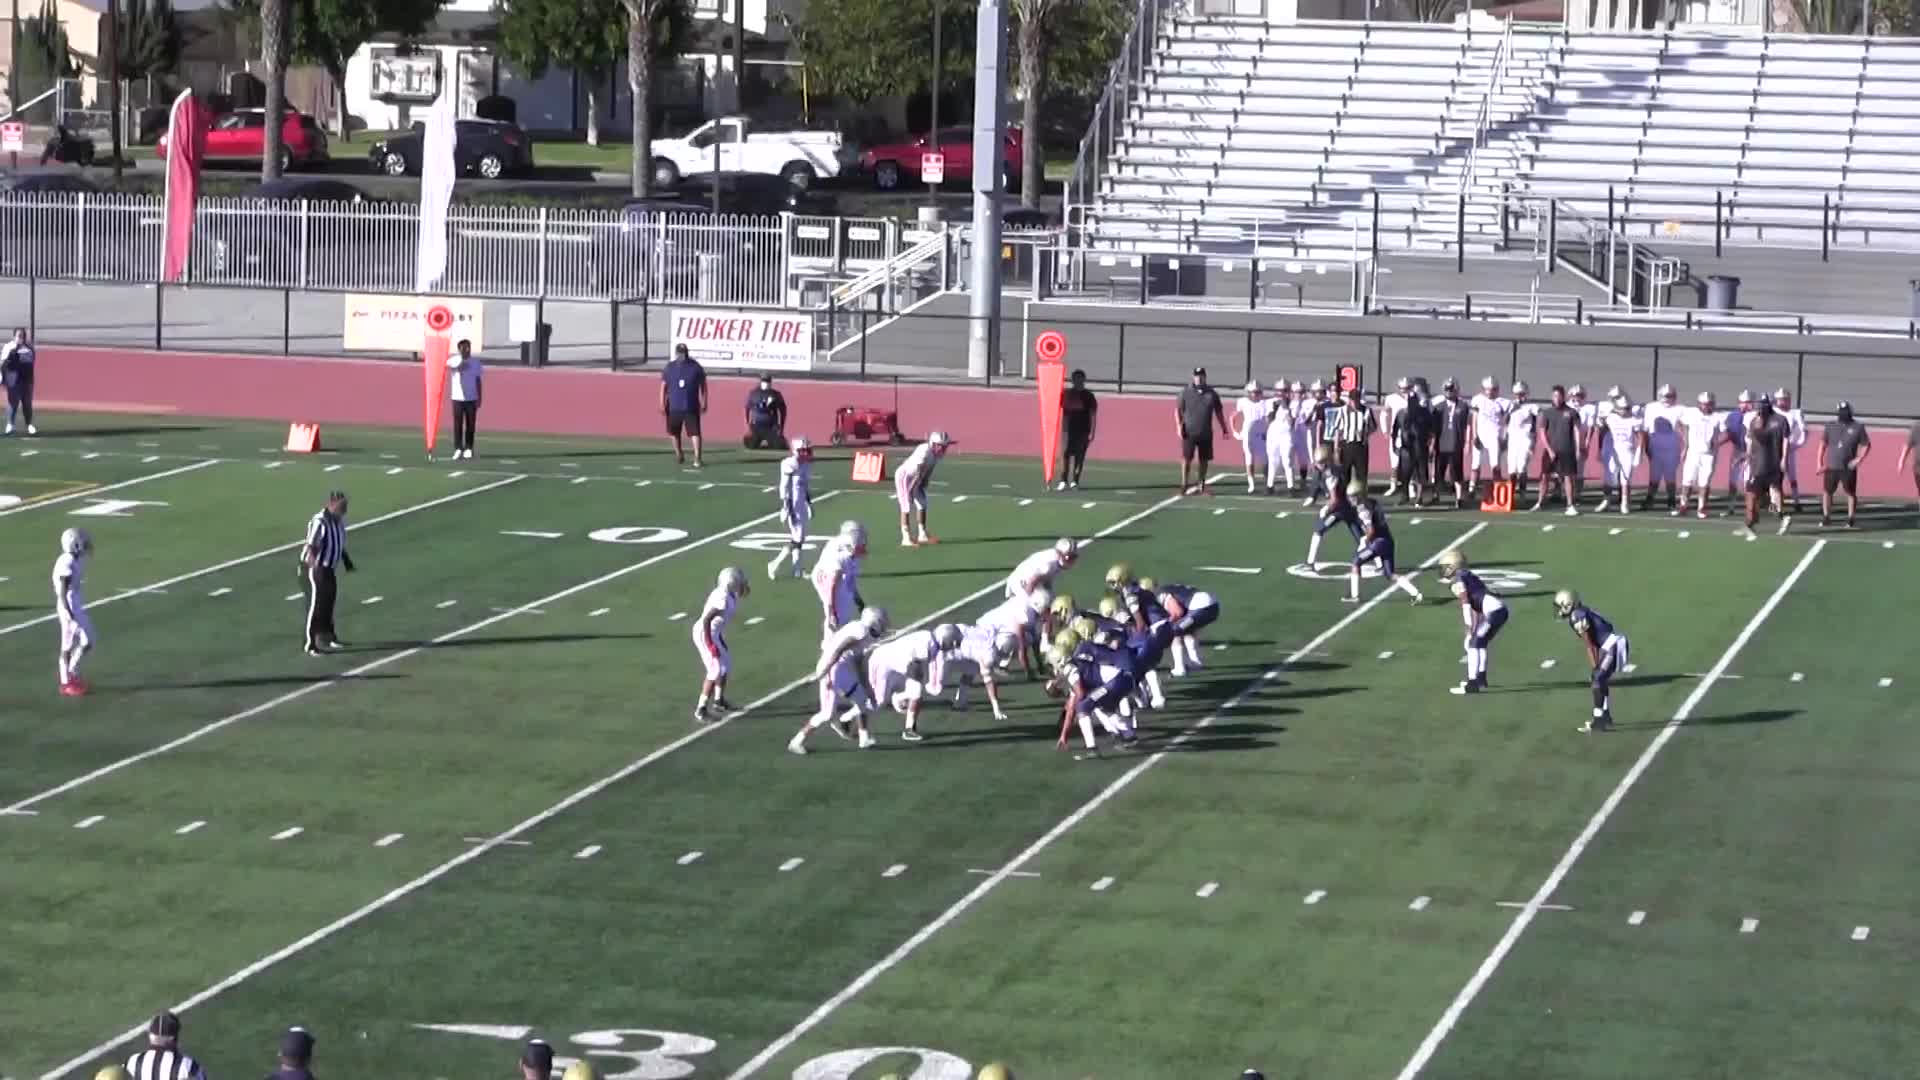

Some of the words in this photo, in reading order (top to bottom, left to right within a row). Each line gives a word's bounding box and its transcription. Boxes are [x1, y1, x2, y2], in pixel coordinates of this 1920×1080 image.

[675, 316, 753, 341] TUCKER
[760, 319, 807, 344] TIRE
[856, 454, 880, 479] 20
